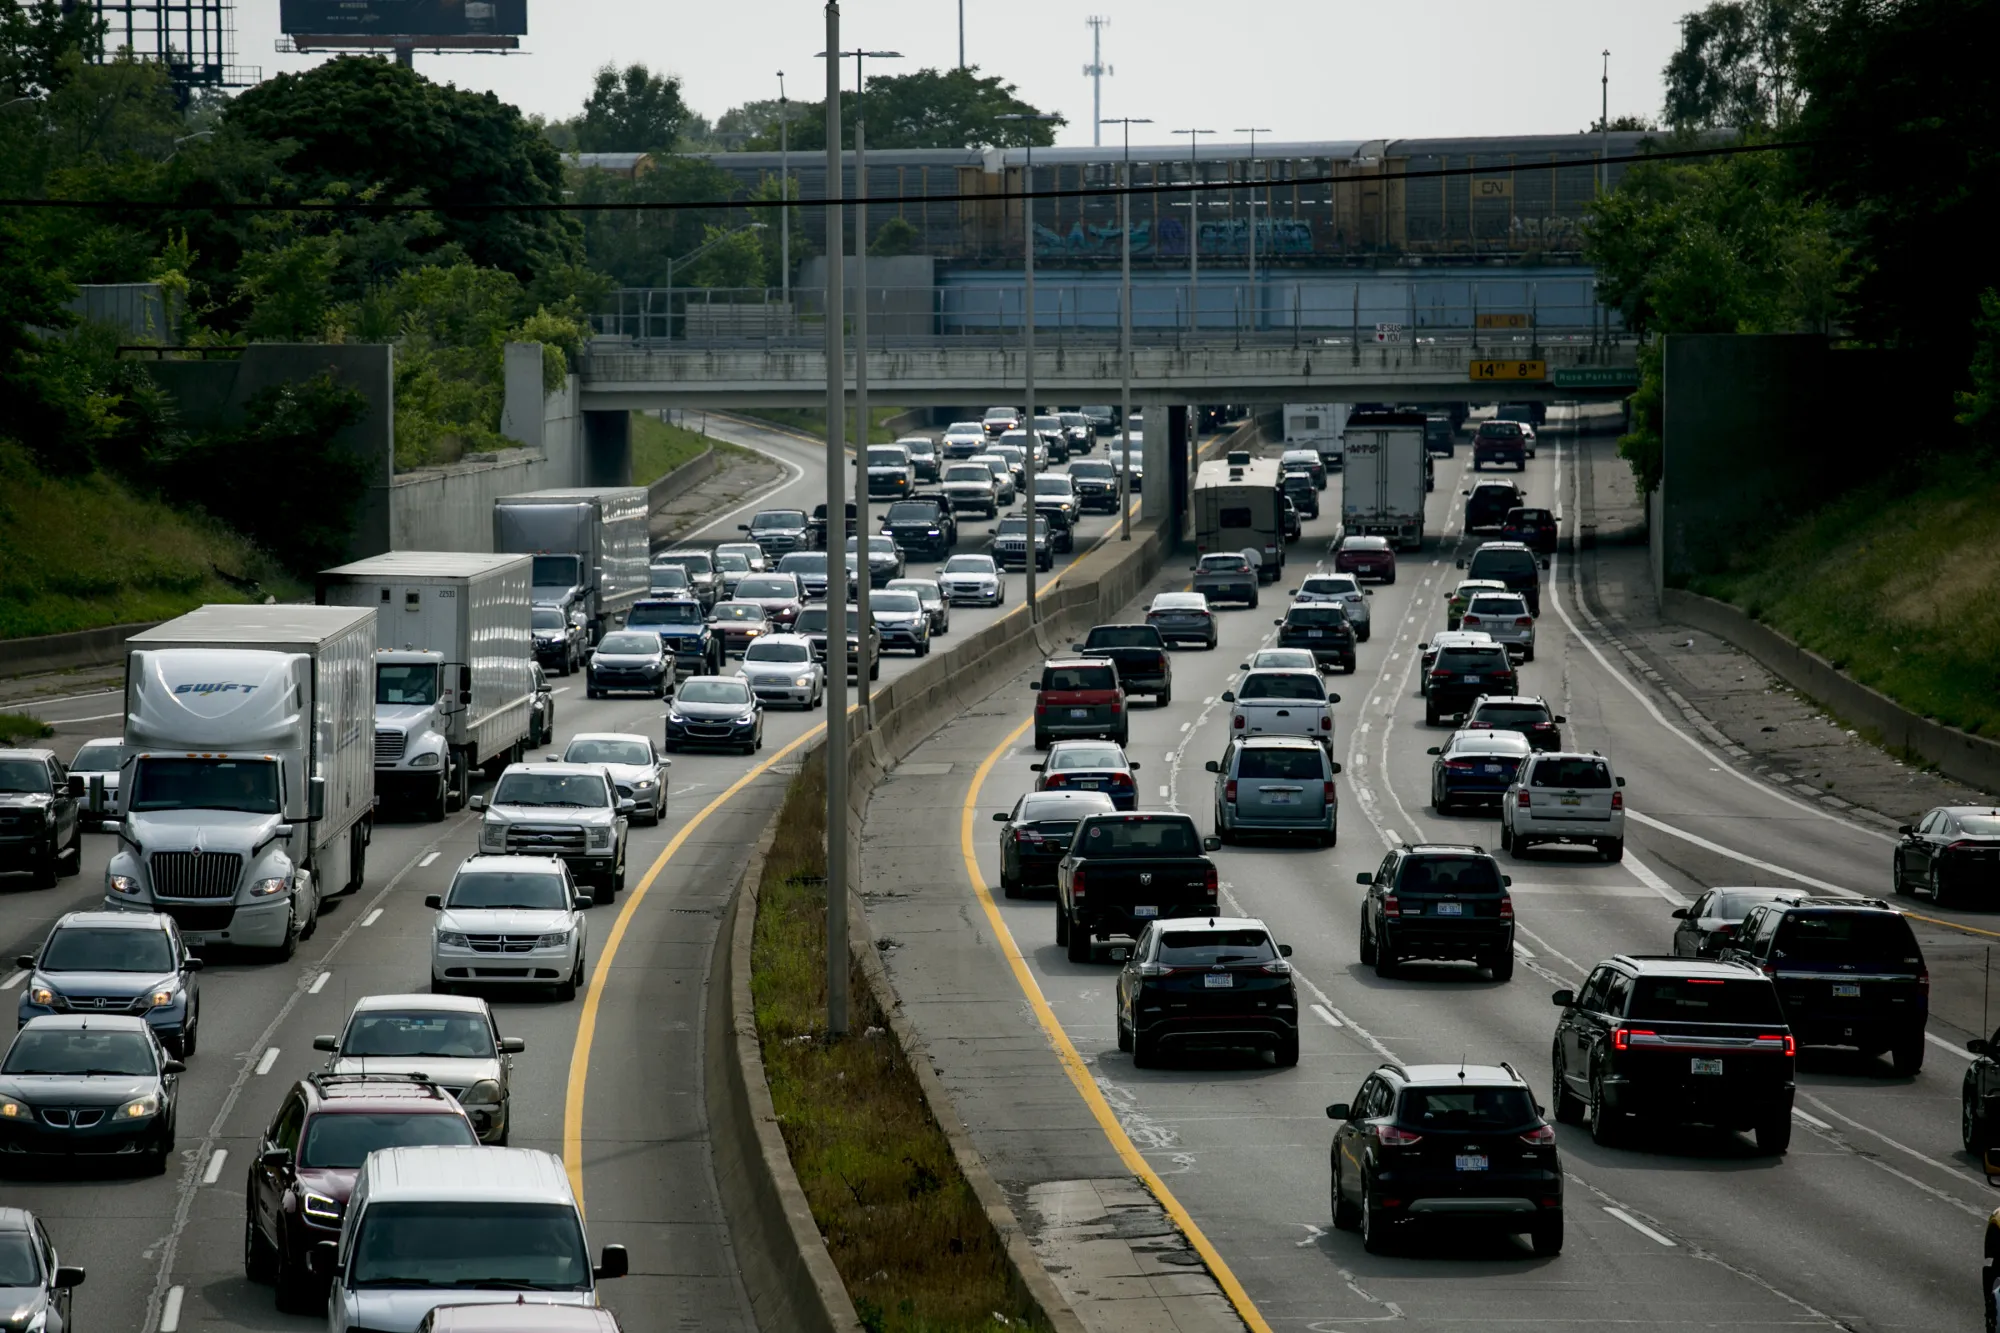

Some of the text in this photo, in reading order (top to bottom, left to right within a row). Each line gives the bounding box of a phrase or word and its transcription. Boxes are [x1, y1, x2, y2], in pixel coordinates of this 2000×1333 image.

[1482, 181, 1503, 194] CN
[1376, 323, 1402, 333] JESUS
[1386, 333, 1401, 342] YOU
[1479, 363, 1494, 377] 14
[1518, 363, 1527, 377] 8
[174, 683, 259, 695] SWIFT
